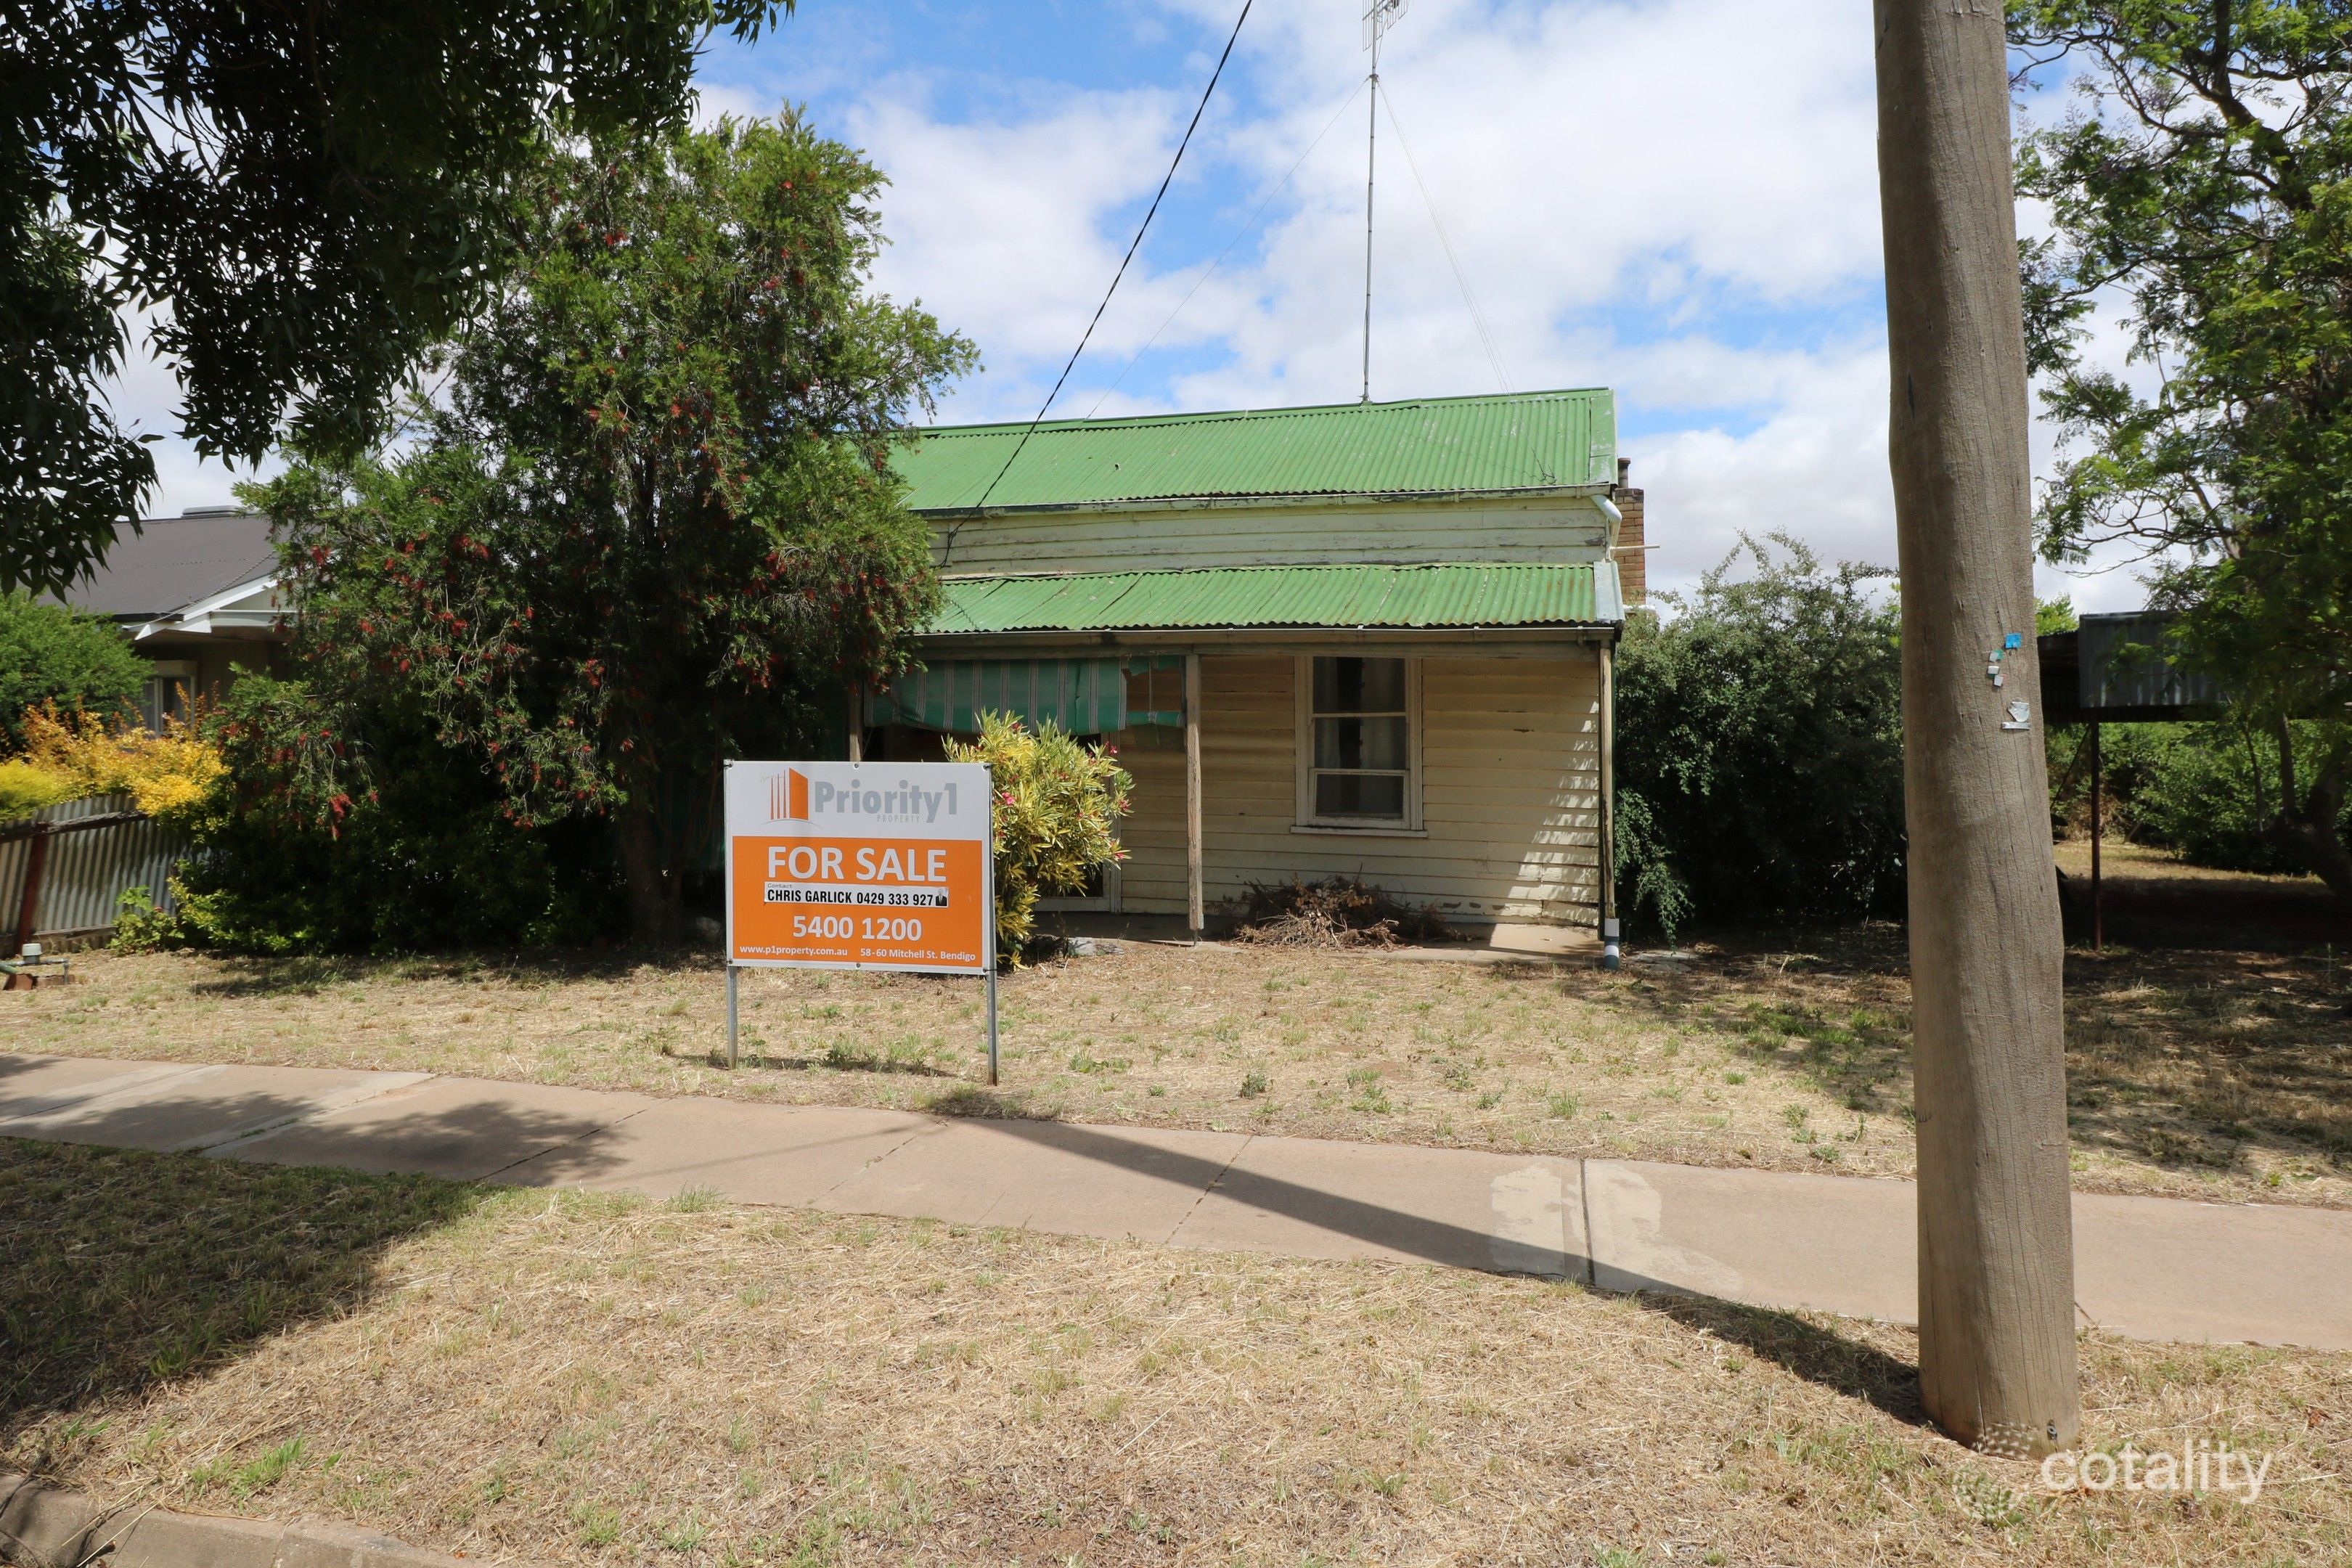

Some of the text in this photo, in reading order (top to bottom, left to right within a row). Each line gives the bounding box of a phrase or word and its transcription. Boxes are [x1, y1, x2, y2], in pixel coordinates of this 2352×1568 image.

[814, 779, 957, 823] Priority1
[877, 814, 920, 823] PROPERTY
[767, 846, 947, 882] FOR SALE
[767, 889, 934, 906] CHRIS GARLICK 0429 333 927
[793, 915, 922, 942] 5400 1200
[739, 945, 848, 955] www.p1property.com.au
[860, 948, 976, 962] 58-60 Mitchell St. Bendigo
